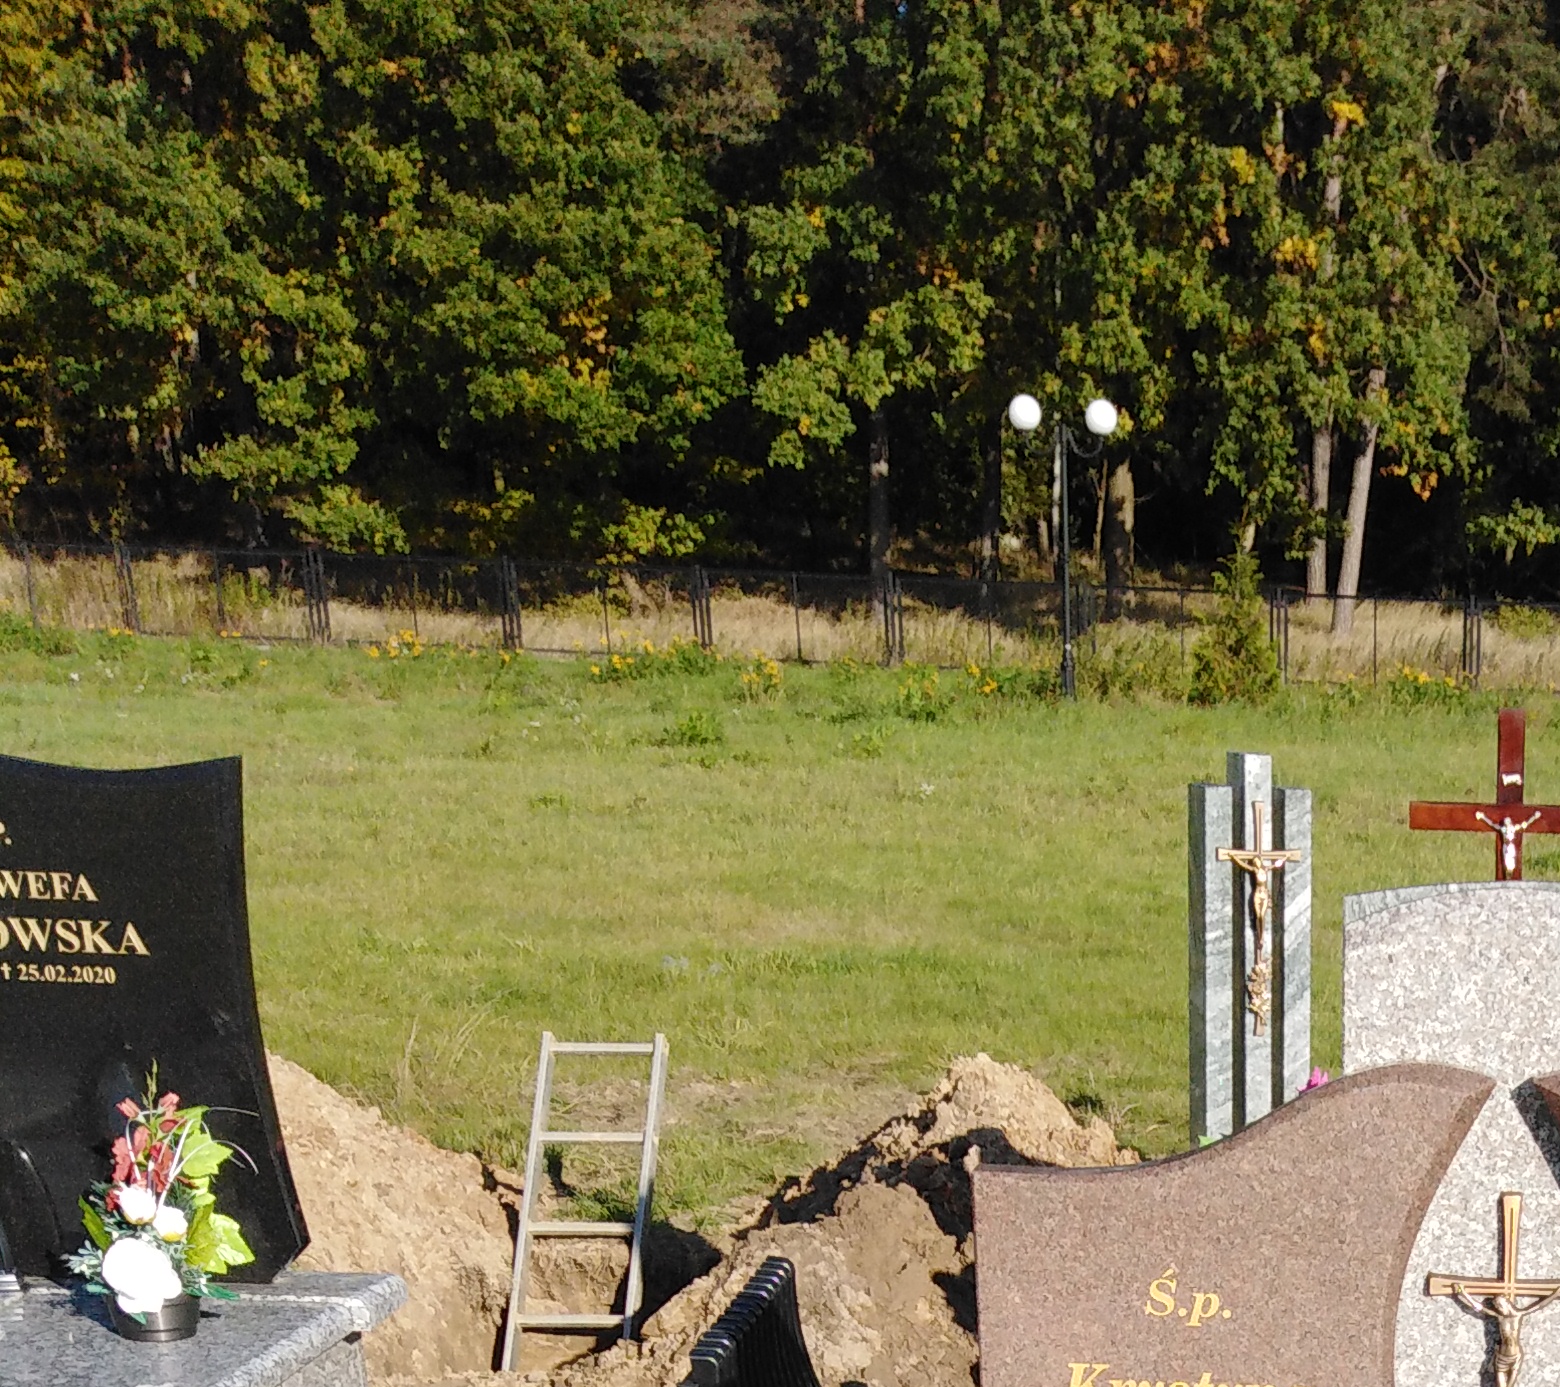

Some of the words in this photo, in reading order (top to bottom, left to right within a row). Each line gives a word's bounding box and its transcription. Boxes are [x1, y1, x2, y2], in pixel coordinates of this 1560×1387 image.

[0, 917, 151, 956] WSKA
[18, 963, 117, 984] 25.02.2020
[1144, 1268, 1233, 1327] Ś.p.
